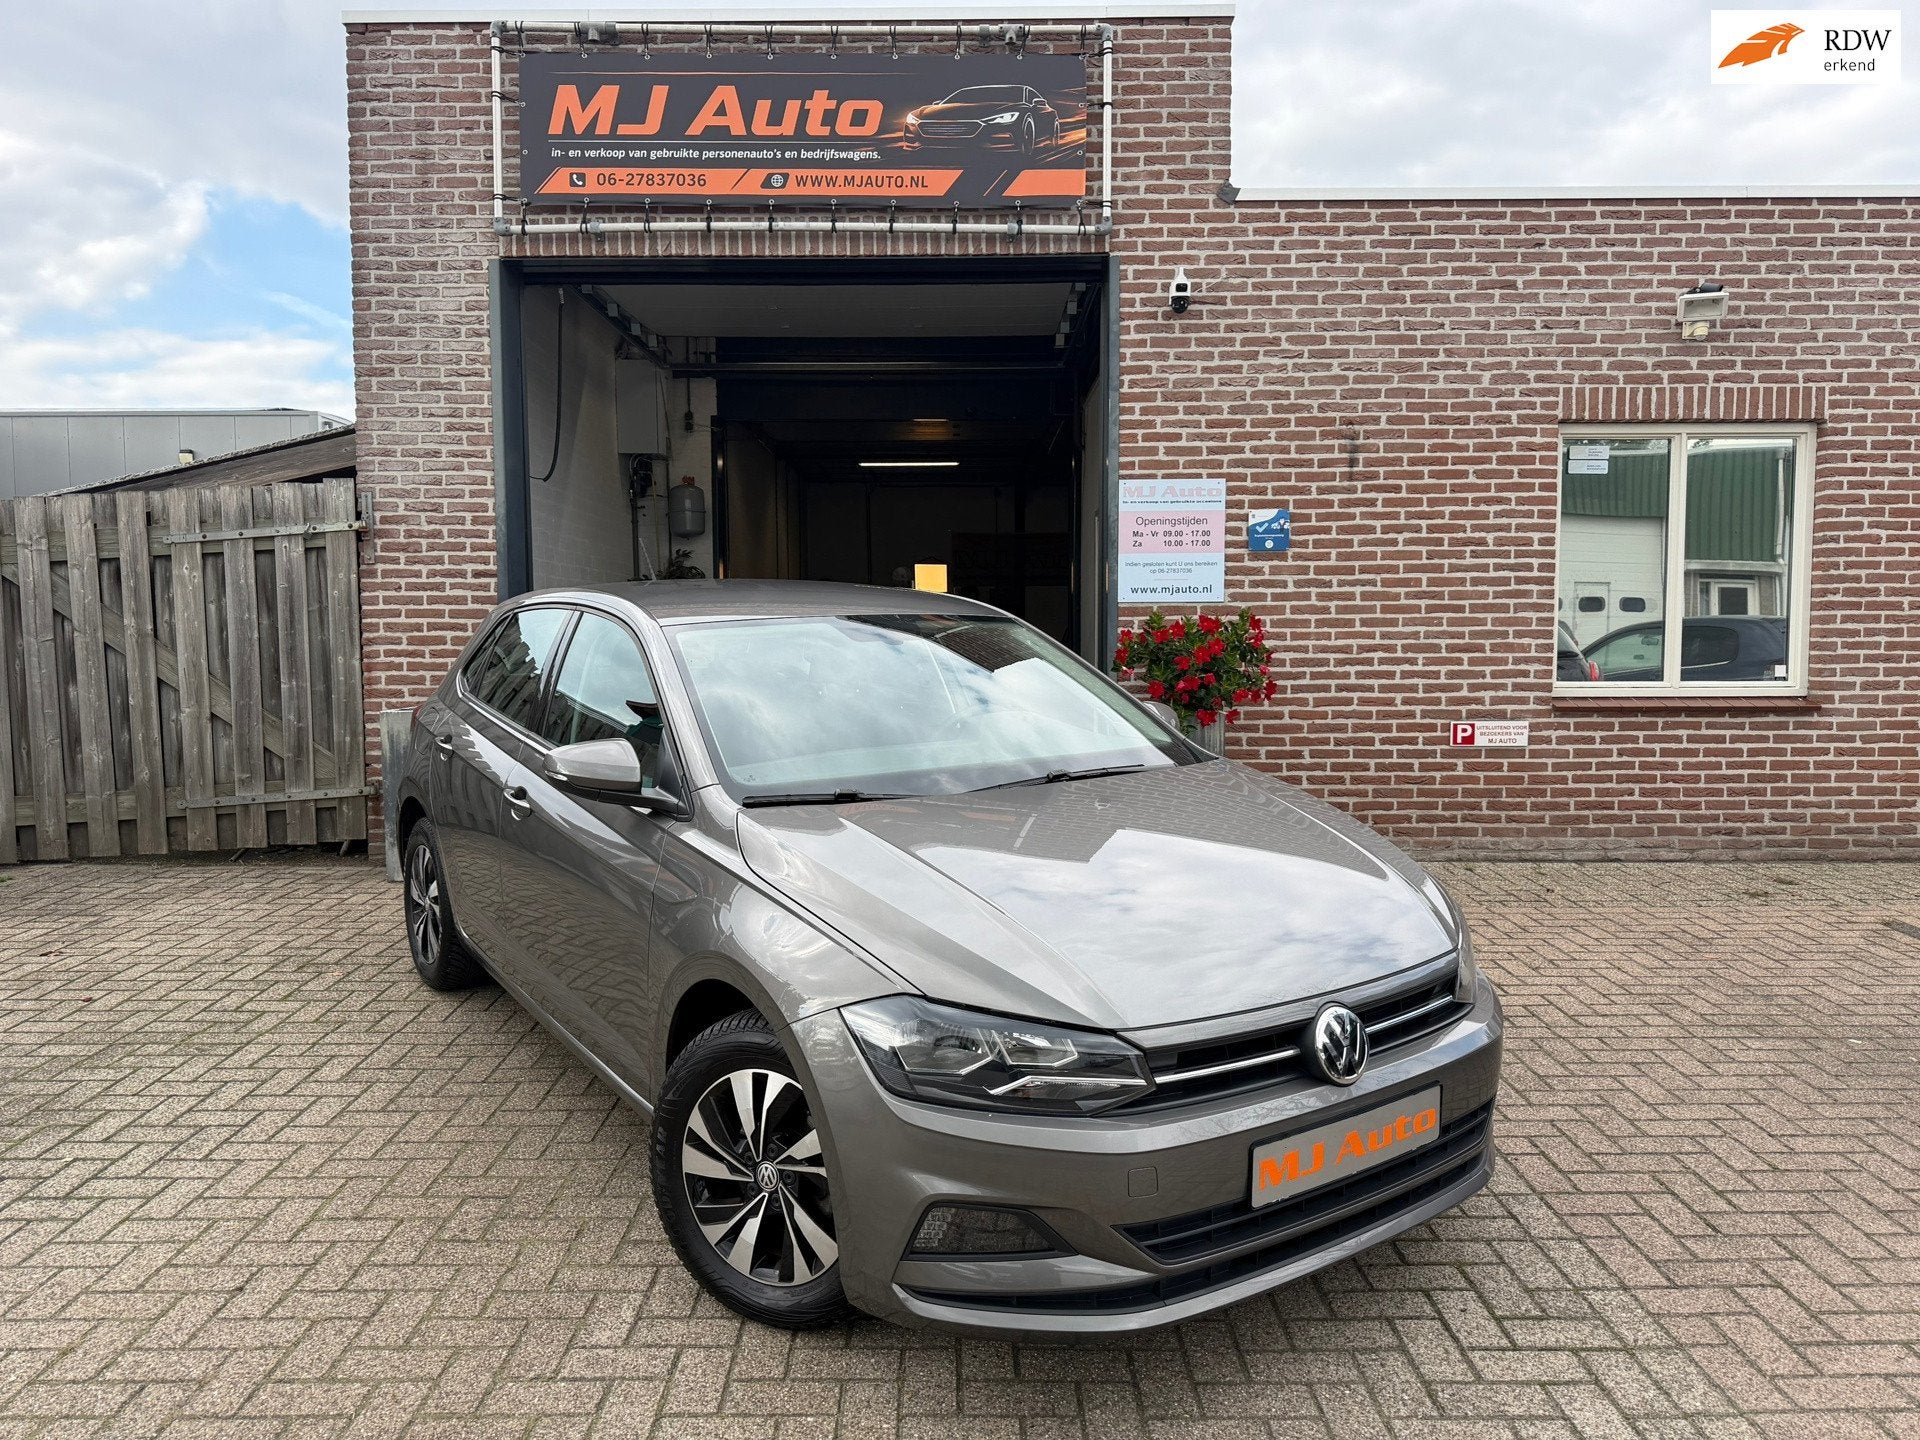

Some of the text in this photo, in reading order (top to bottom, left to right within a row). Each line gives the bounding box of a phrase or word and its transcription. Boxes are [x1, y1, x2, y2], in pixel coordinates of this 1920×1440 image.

[547, 84, 884, 136] MJ Auto
[551, 148, 565, 157] in-
[584, 148, 626, 159] verkoop
[628, 150, 647, 158] van
[650, 148, 700, 160] gebruikte
[701, 149, 782, 160] personenauto's
[785, 150, 798, 159] en
[801, 149, 882, 161] bedrijfswagens.
[596, 172, 707, 187] 06-27837036
[795, 174, 928, 188] WWW.MJAUTO.NL
[1123, 486, 1222, 498] MJ Auto
[1135, 516, 1208, 527] Openingstijden
[1132, 530, 1144, 538] Ma
[1150, 530, 1159, 538] Vr
[1130, 584, 1213, 595] www.mjauto.nl
[1456, 724, 1473, 744] P
[1258, 1107, 1437, 1192] MJ Auto
